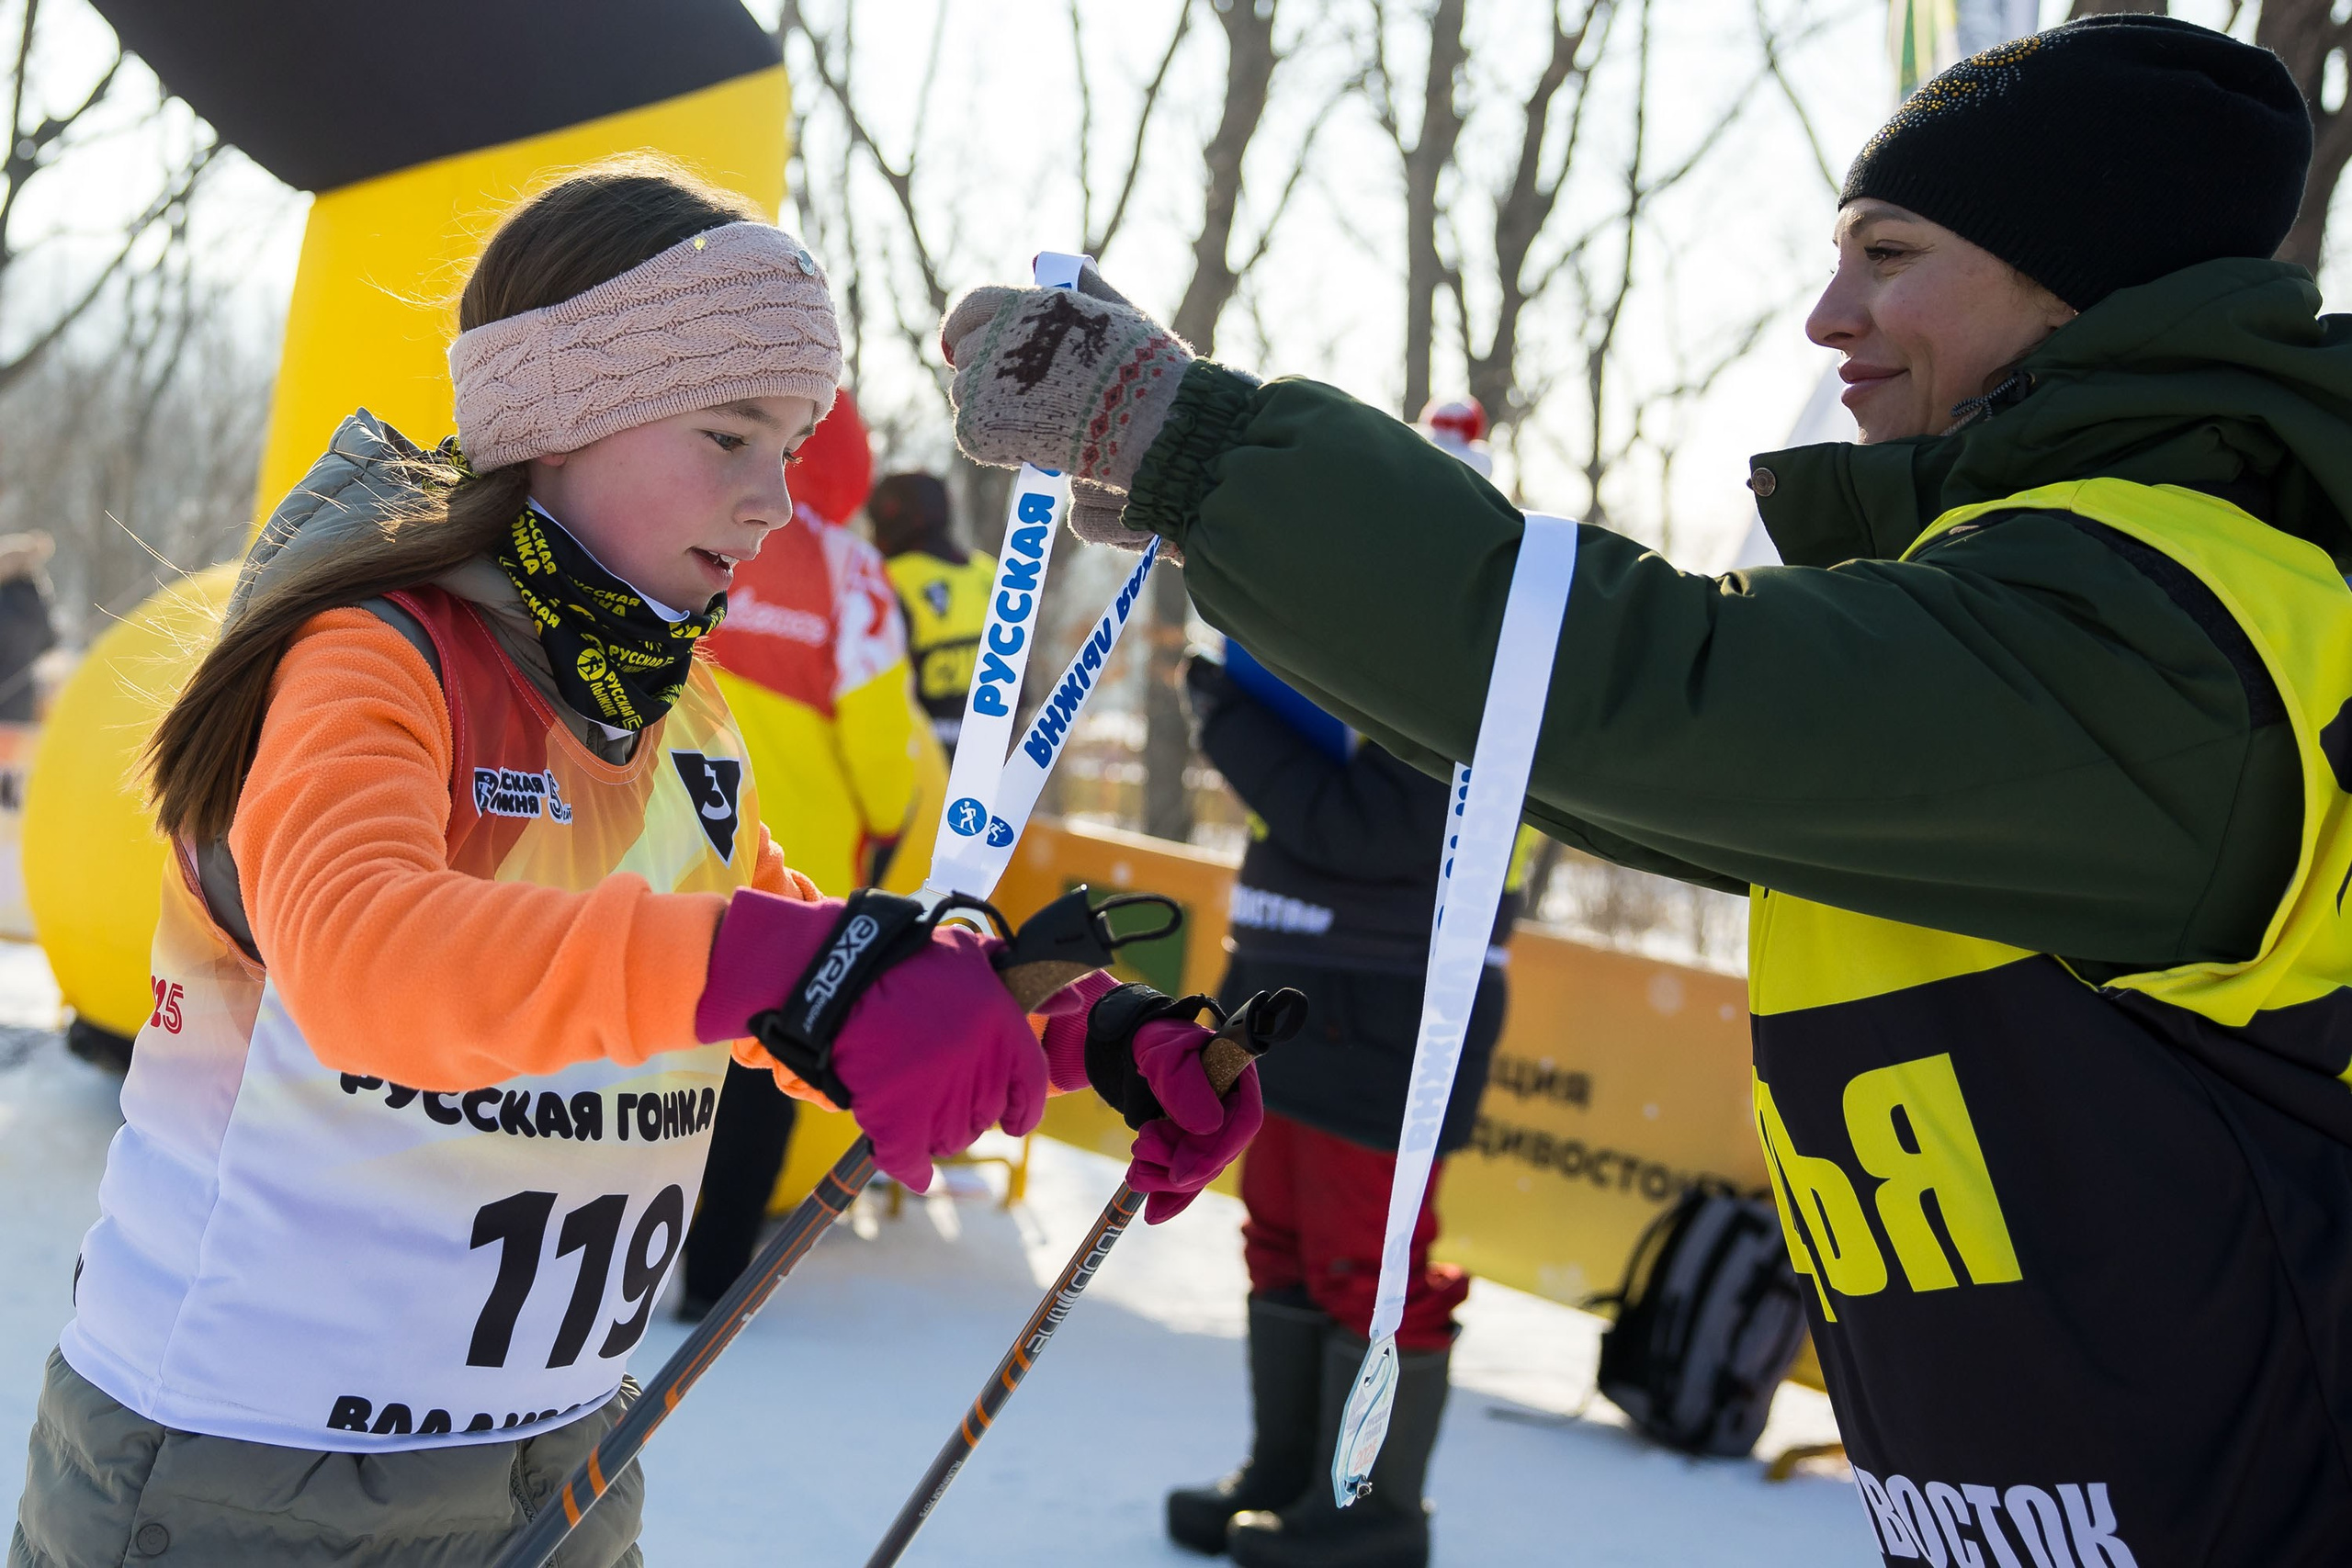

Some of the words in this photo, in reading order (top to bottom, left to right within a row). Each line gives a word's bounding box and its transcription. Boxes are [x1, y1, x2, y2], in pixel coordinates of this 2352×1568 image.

[973, 492, 1055, 717] РУССКАЯ
[617, 1087, 716, 1142] ГОНКА
[466, 1183, 684, 1369] 119
[1853, 1465, 2139, 1567] ВОСТОК
